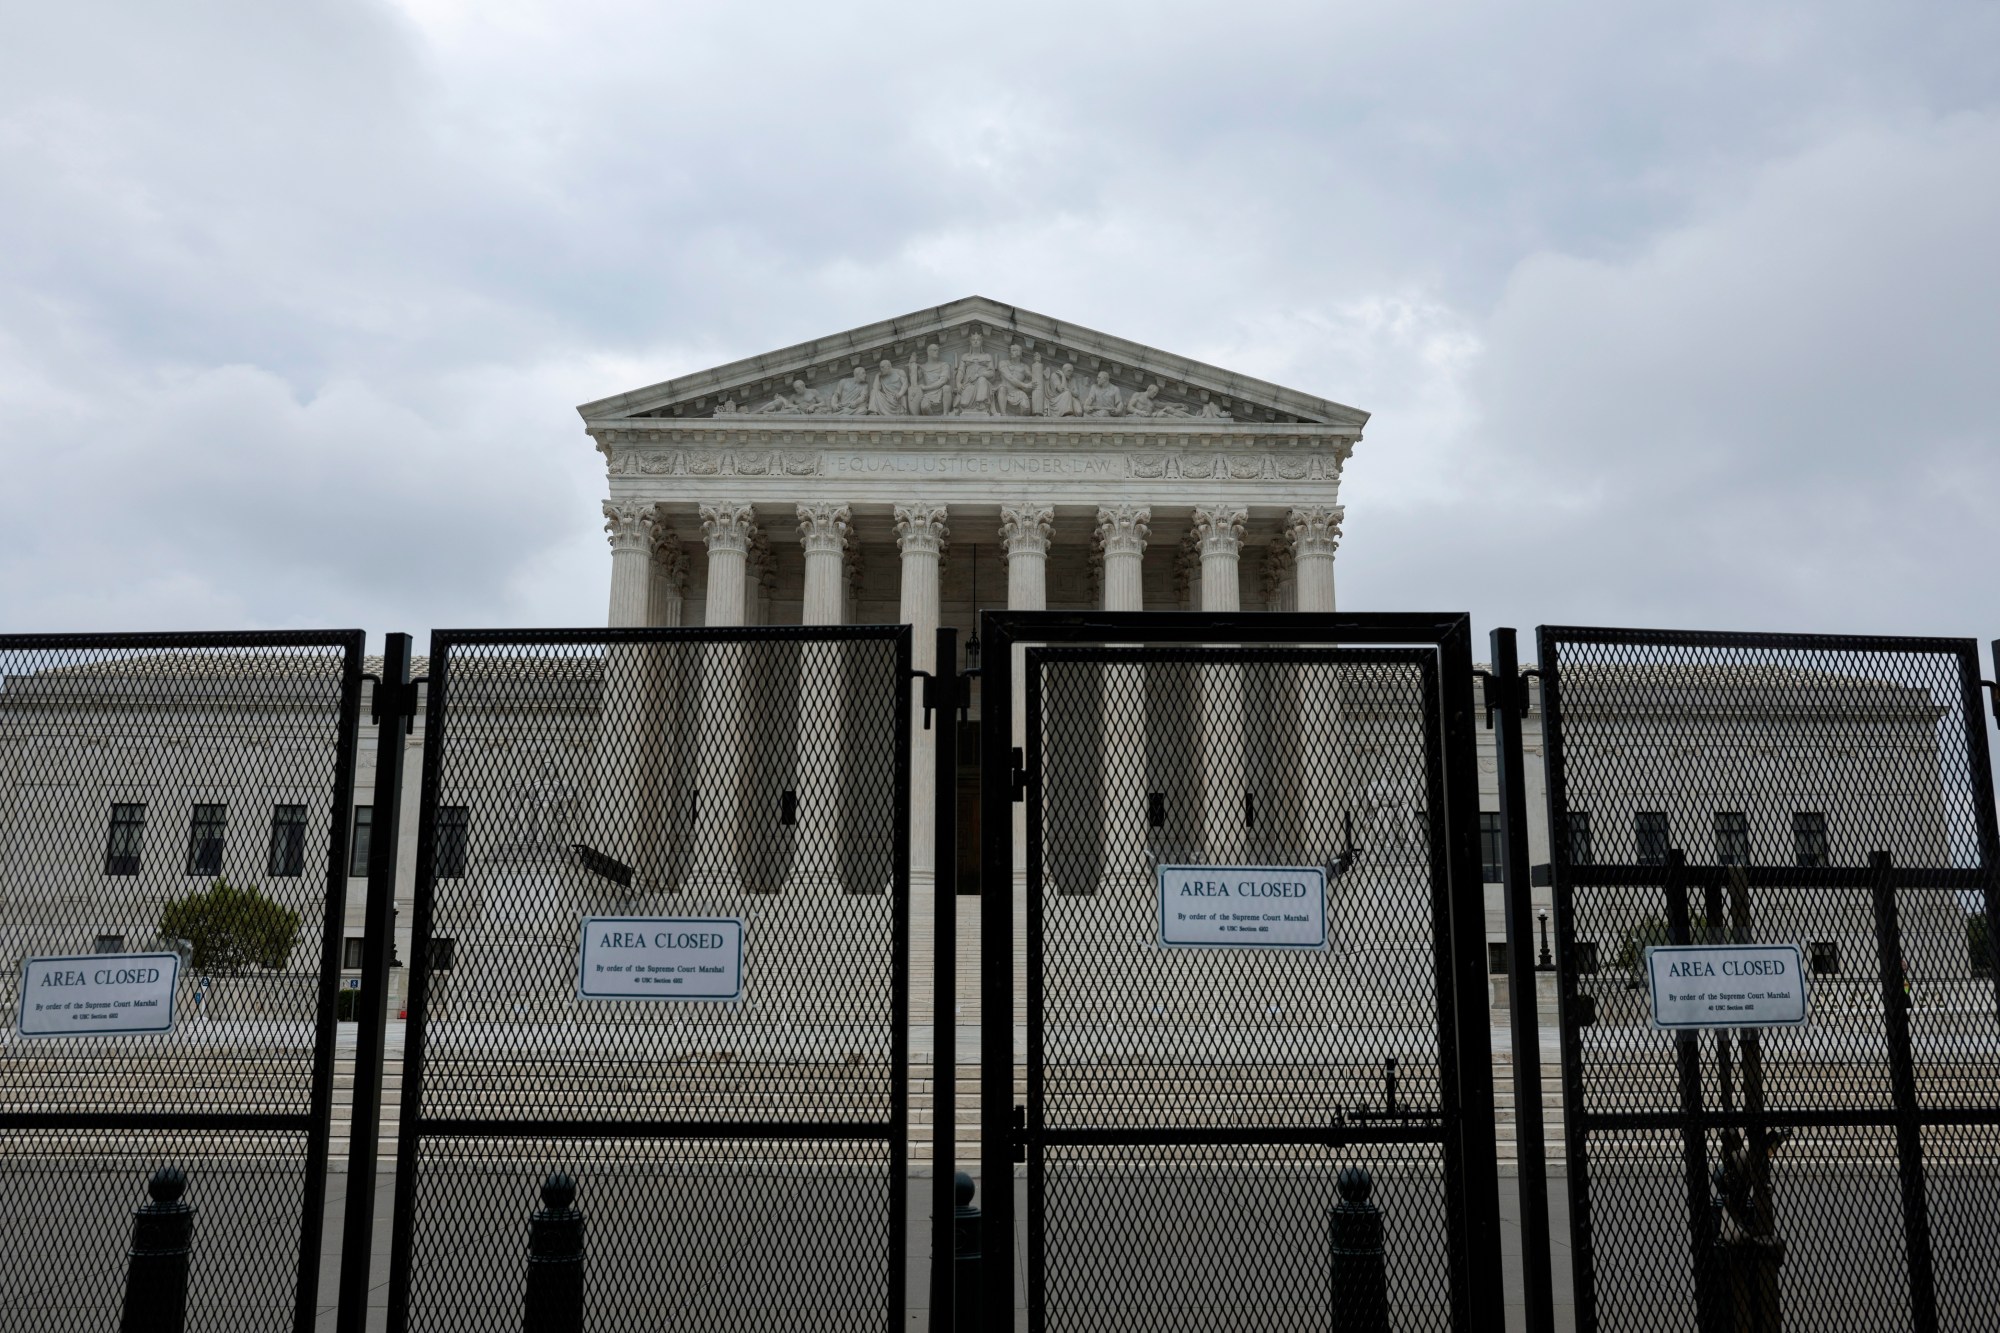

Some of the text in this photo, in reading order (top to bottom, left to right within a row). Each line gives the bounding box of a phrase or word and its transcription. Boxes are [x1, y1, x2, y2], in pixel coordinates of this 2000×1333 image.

[838, 457, 1111, 473] EQUAL JUSTICE UNDER LAW
[1180, 881, 1306, 898] AREA CLOSED
[1178, 913, 1186, 921] By
[1220, 913, 1230, 921] the
[1232, 914, 1260, 922] Supreme
[600, 933, 724, 949] AREA CLOSED
[596, 965, 604, 973] By
[647, 965, 674, 974] Supreme
[1669, 960, 1785, 977] AREA CLOSED
[40, 969, 159, 987] AREA CLOSED
[1669, 994, 1677, 1002] By
[1680, 993, 1696, 1001] order
[1719, 993, 1745, 1001] Supreme
[85, 1002, 111, 1010] Supreme
